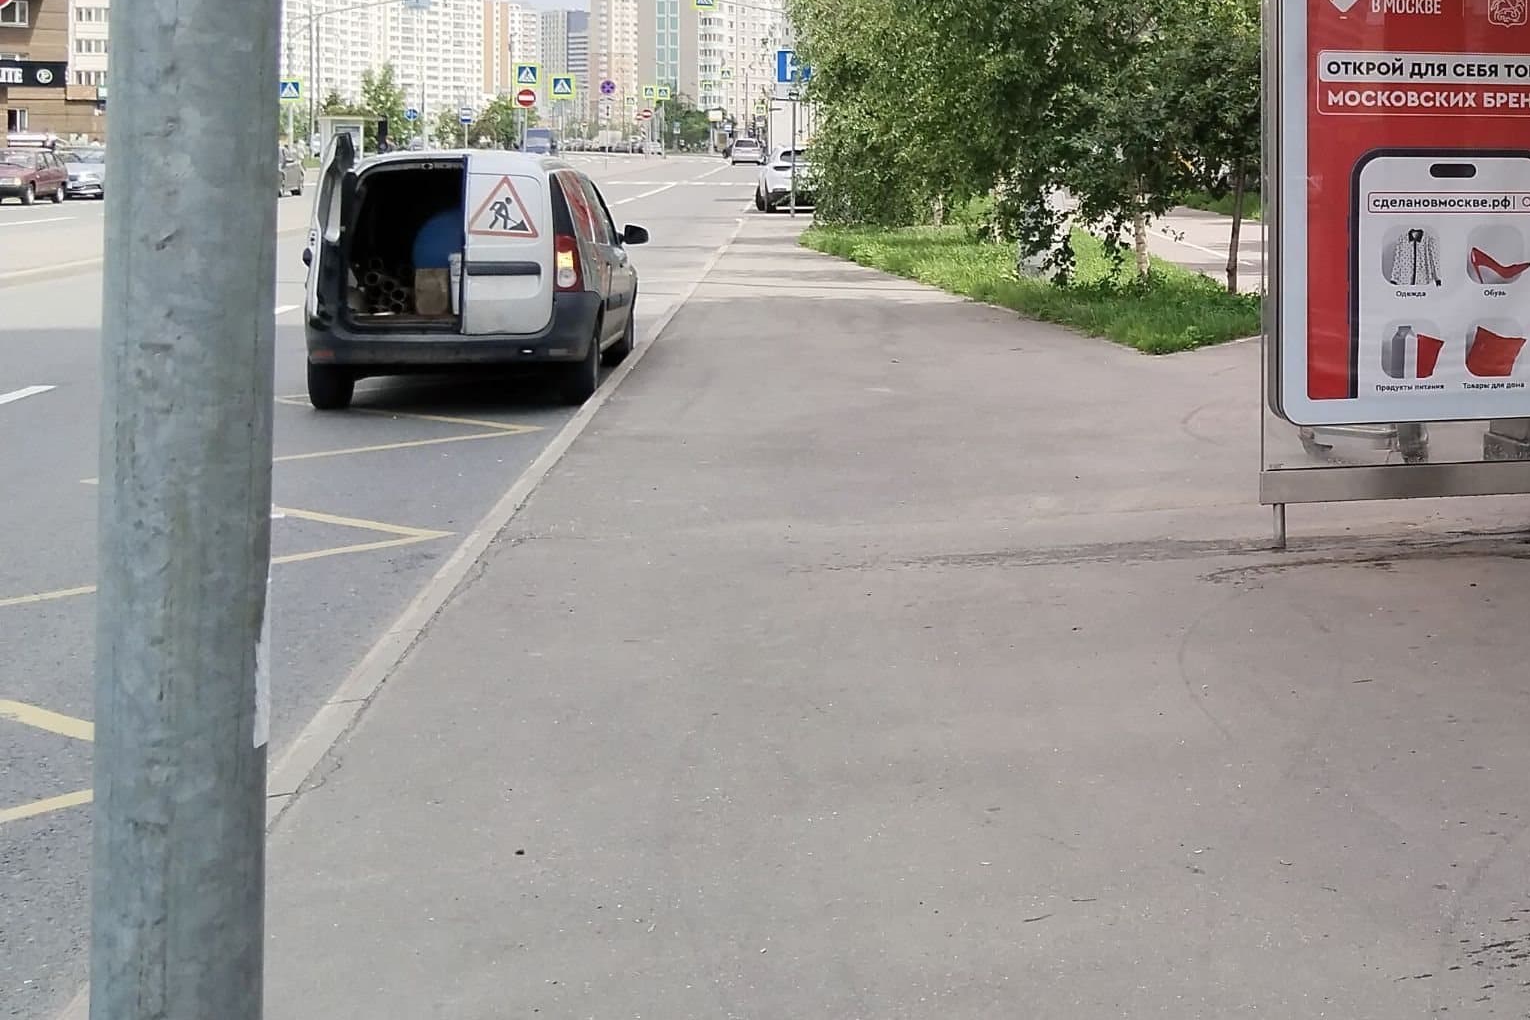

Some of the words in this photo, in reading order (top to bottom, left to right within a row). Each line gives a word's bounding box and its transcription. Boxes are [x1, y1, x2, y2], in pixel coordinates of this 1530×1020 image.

[1327, 58, 1404, 77] ОТКРОЙ
[1409, 62, 1447, 79] ДЛЯ
[1452, 63, 1499, 78] СЕБЯ
[1327, 90, 1477, 108] МОСКОВСКИХ
[1372, 195, 1511, 211] сделановмоскве.рф
[1395, 290, 1427, 298] Одежда
[1484, 289, 1506, 297] Обувь
[1376, 383, 1413, 392] Продукты
[1463, 381, 1490, 389] Товары
[1490, 382, 1505, 390] для
